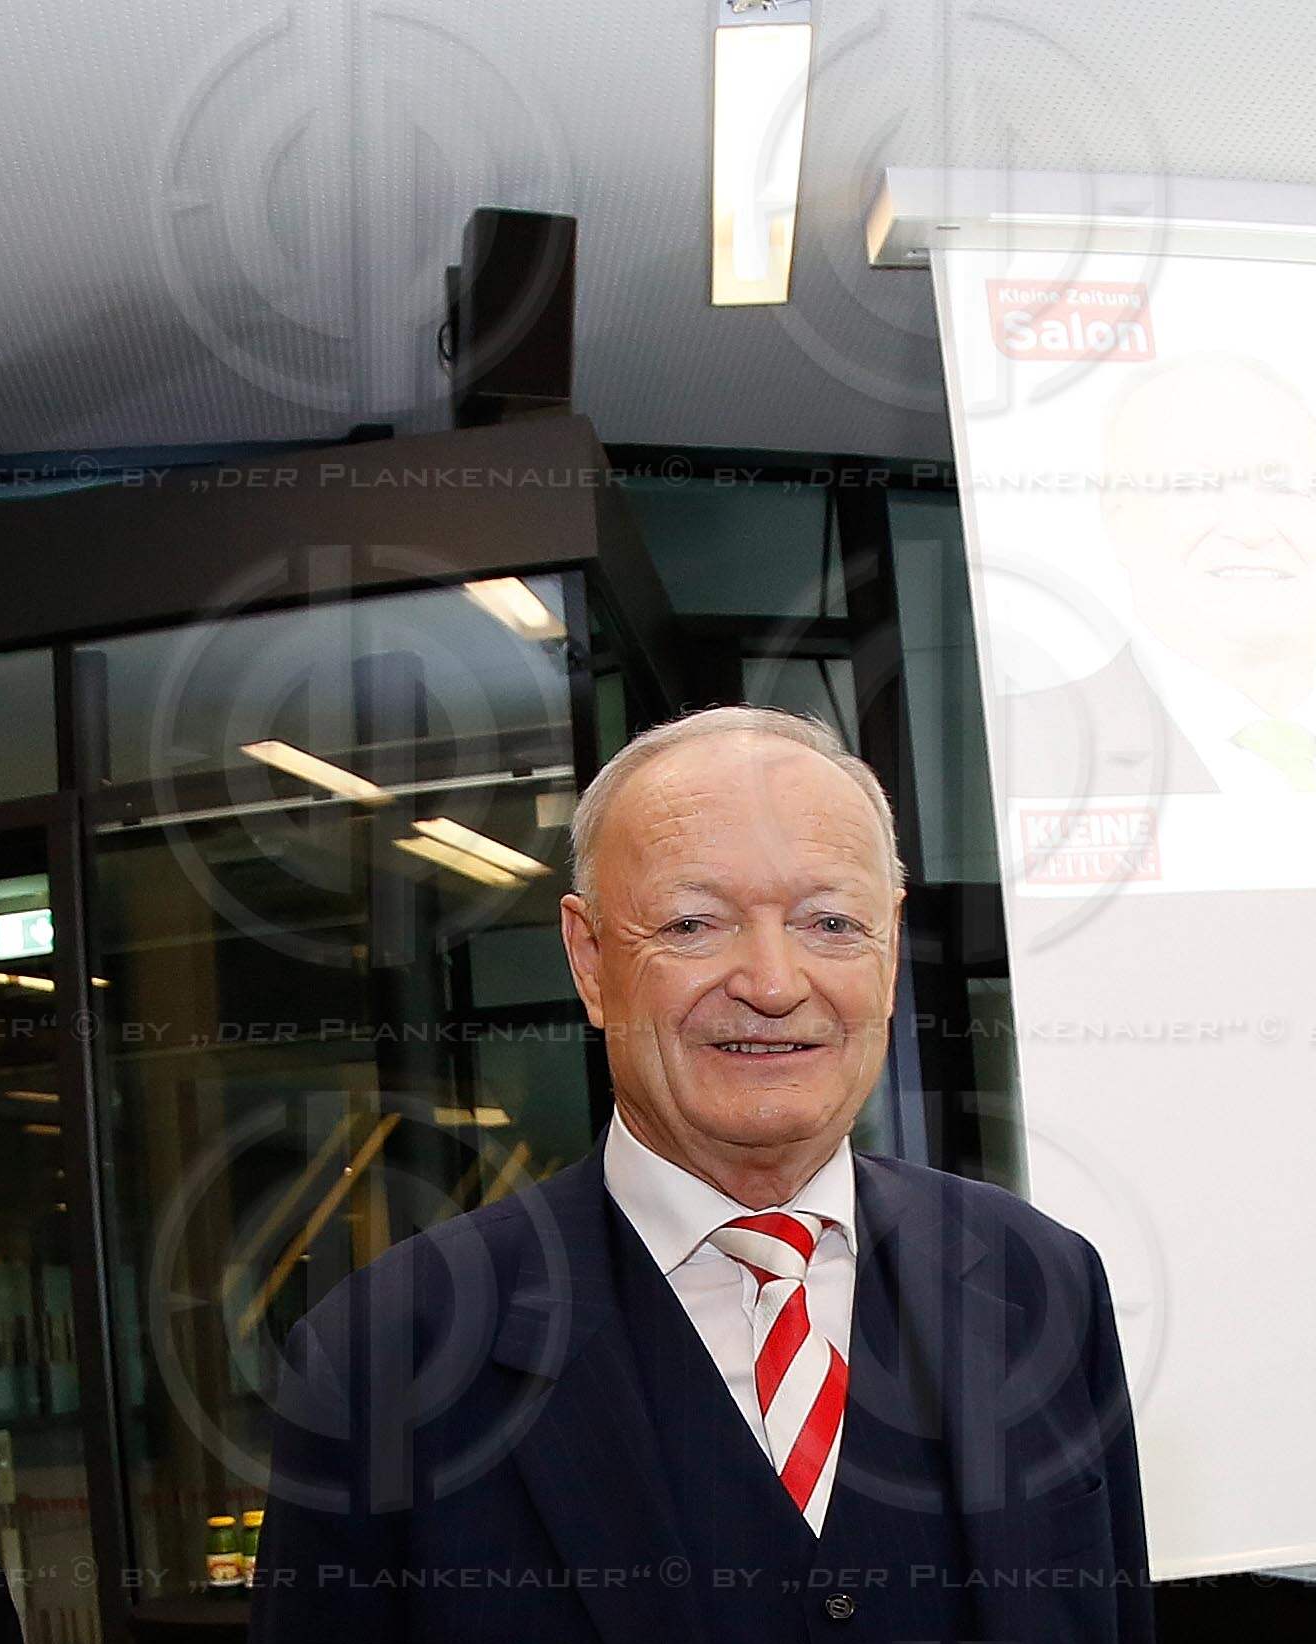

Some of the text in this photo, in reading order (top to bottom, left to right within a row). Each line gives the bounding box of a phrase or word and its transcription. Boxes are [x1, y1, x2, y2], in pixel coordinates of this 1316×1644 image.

[998, 287, 1141, 309] Kleine Zeitung
[1003, 309, 1149, 353] Salon
[1025, 813, 1152, 848] KLEINE
